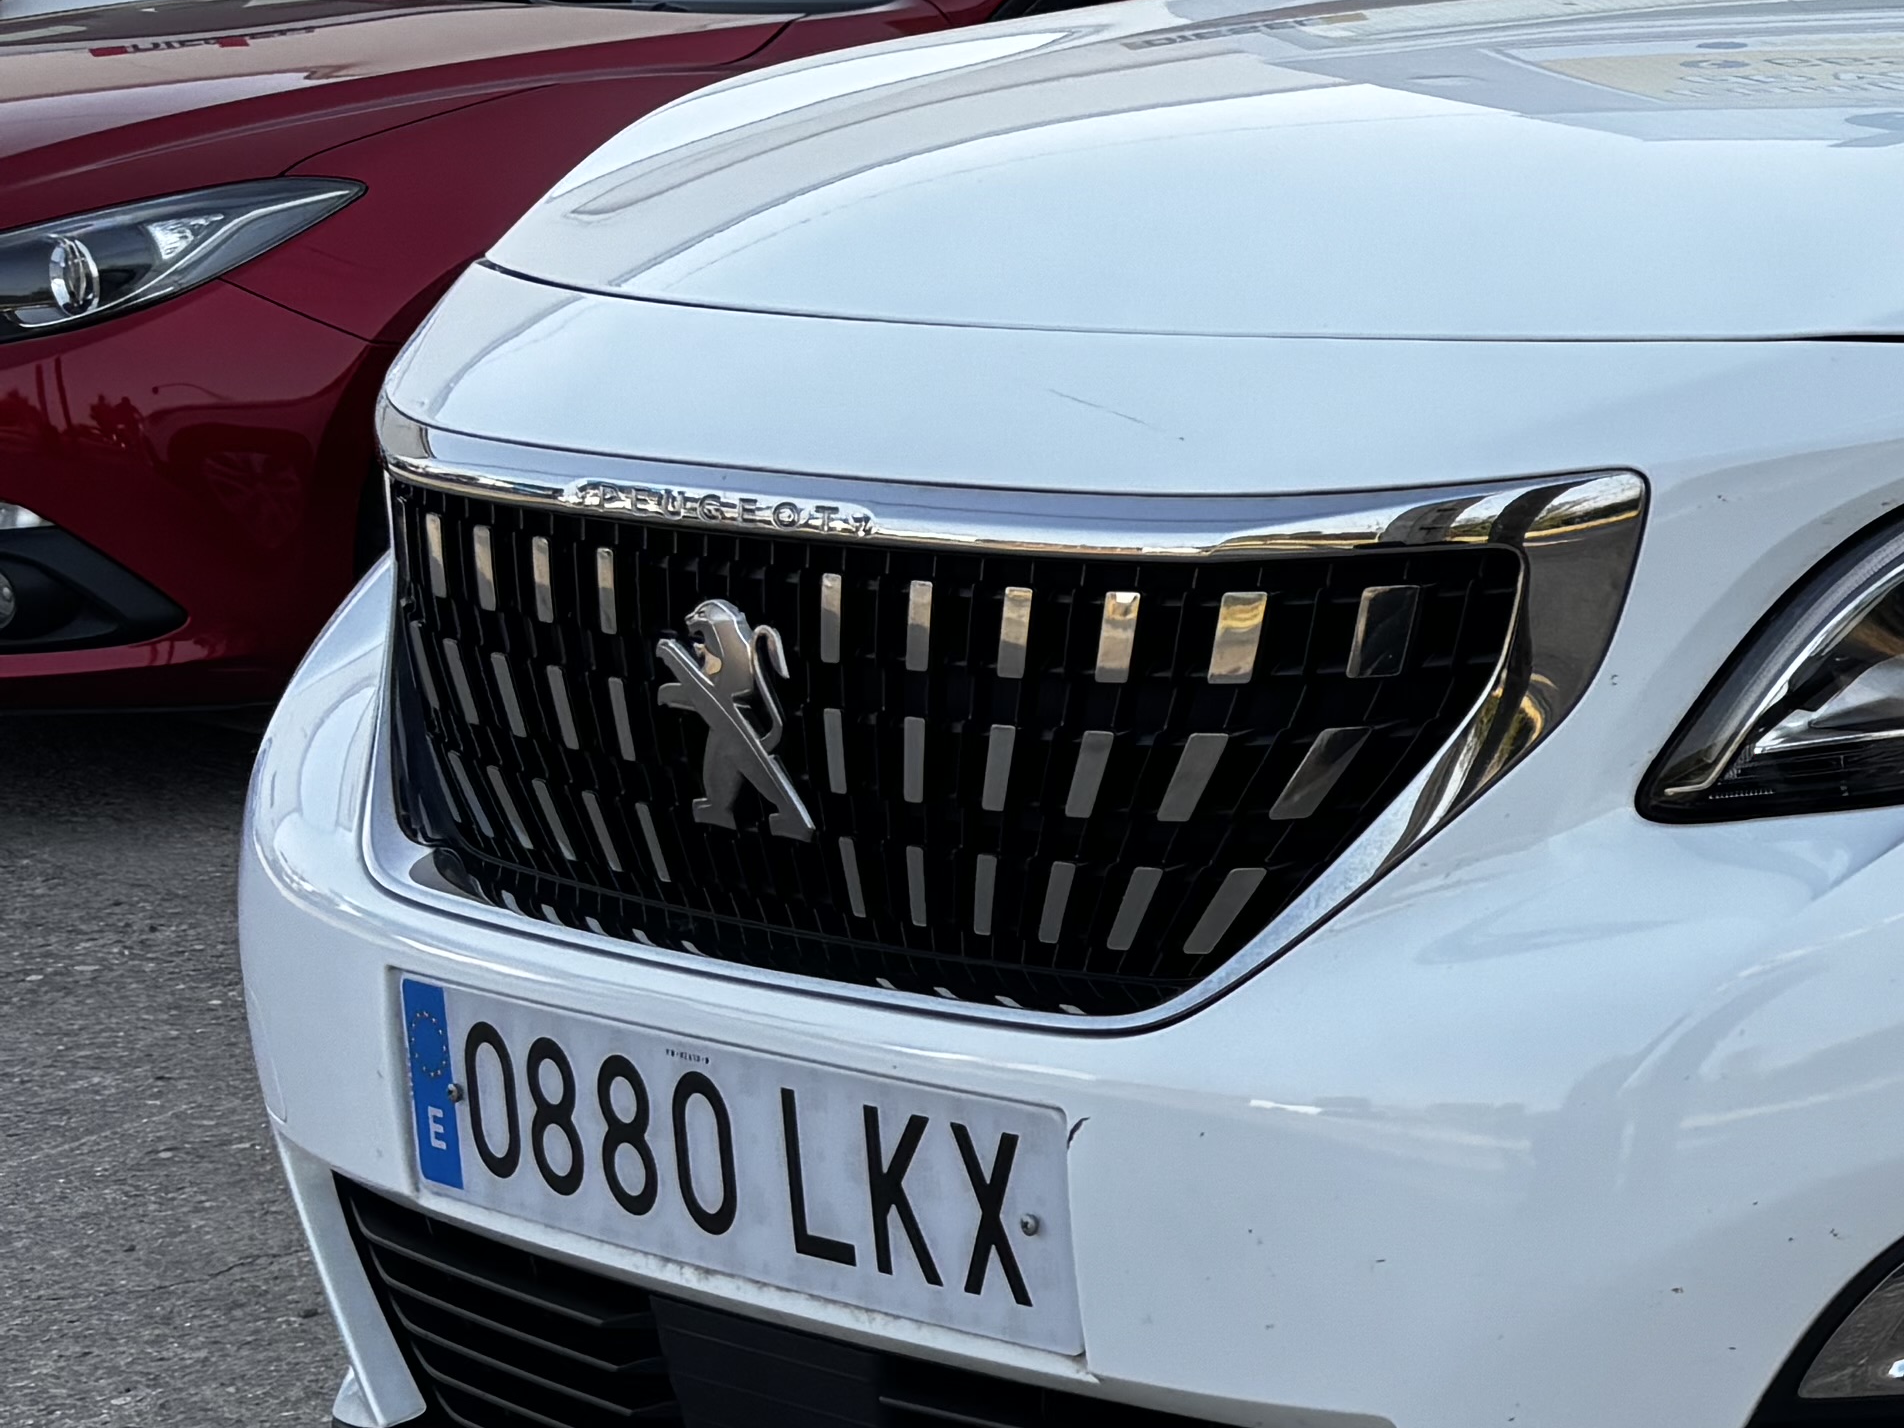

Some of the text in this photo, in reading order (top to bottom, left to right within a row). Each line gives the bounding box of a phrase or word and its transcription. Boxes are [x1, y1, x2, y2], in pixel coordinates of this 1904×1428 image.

[597, 482, 840, 536] PEUGEOT
[427, 1105, 447, 1150] E
[463, 1021, 1033, 1308] 0880 LKX
